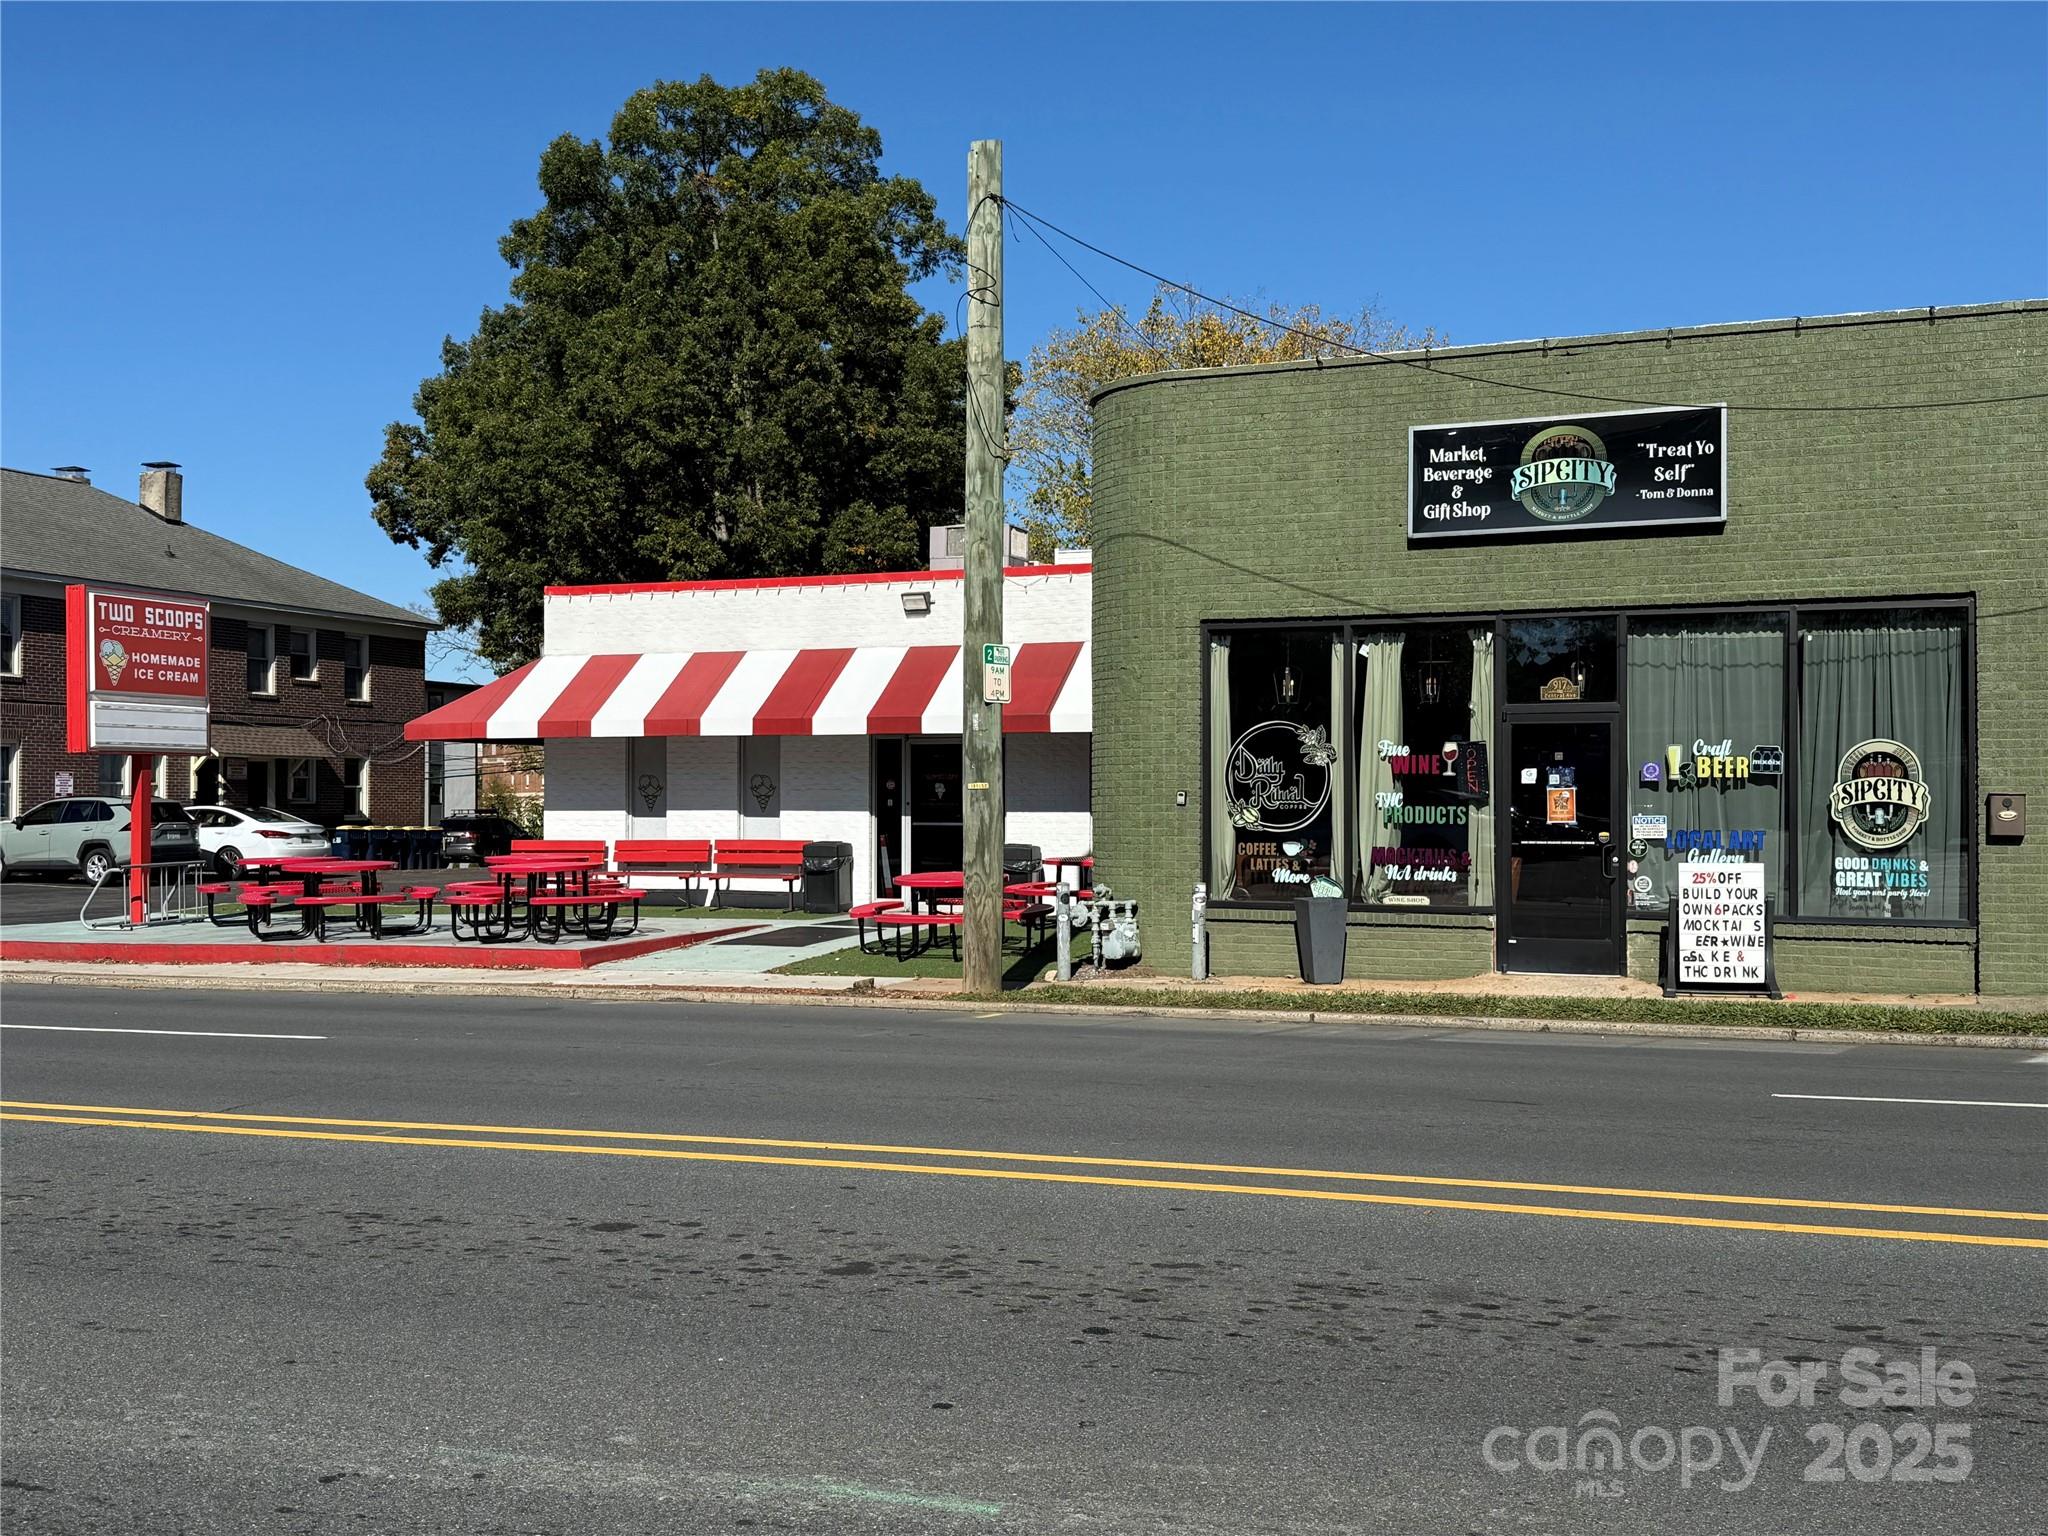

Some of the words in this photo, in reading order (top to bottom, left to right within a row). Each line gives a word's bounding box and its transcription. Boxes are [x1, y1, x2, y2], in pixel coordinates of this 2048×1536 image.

[1430, 445, 1487, 464] Market,
[1637, 442, 1694, 459] "Treat
[1695, 440, 1715, 456] Yo
[1424, 465, 1492, 484] Beverage
[1519, 459, 1611, 488] SIPCITY
[1654, 463, 1696, 484] Self"
[1451, 485, 1464, 499] &
[1635, 488, 1665, 500] -Tom
[1666, 487, 1675, 499] &
[1676, 486, 1714, 498] Donna
[1423, 504, 1451, 522] Gift
[1452, 502, 1491, 521] Shop
[98, 602, 134, 623] TWO
[145, 607, 203, 630] SCOOPS
[112, 625, 191, 642] CREAMERY
[132, 652, 201, 668] HOMEMADE
[987, 649, 993, 661] 2
[134, 669, 154, 680] ICE
[158, 671, 199, 683] CREAM
[991, 666, 1005, 674] 9AM
[993, 678, 1002, 686] TO
[1553, 679, 1567, 690] 917
[991, 690, 1005, 698] 4PM
[1378, 739, 1411, 757] Fine
[1693, 739, 1732, 761] Craft
[1392, 755, 1440, 775] WINE
[1466, 749, 1480, 793] OPEN
[1697, 756, 1749, 778] BEER
[1841, 778, 1920, 805] SIPCITY
[1375, 792, 1404, 808] THC
[1384, 805, 1466, 824] PRODUCTS
[1666, 830, 1725, 850] LOCAL
[1729, 830, 1766, 851] ART
[1238, 842, 1280, 857] COFFEE,
[1372, 847, 1457, 866] MOCKTAILS
[1461, 851, 1472, 865] &
[1687, 847, 1745, 863] Gallery
[1250, 858, 1289, 870] LATTES
[1293, 861, 1300, 870] &
[1835, 857, 1869, 870] GOOD
[1871, 858, 1916, 870] DRINKS
[1919, 860, 1929, 871] &
[1272, 868, 1311, 883] More
[1385, 864, 1411, 880] NA
[1414, 866, 1457, 882] drinks
[1692, 872, 1716, 884] 25%
[1718, 872, 1742, 884] OFF
[1835, 871, 1882, 887] GREAT
[1885, 872, 1927, 888] VIBES
[1683, 888, 1721, 900] BUILD
[1726, 888, 1758, 900] YOUR
[1853, 889, 1871, 899] your
[1887, 889, 1908, 900] party
[1737, 950, 1744, 962] &
[1685, 966, 1708, 978] THC
[1714, 966, 1759, 978] DRINK
